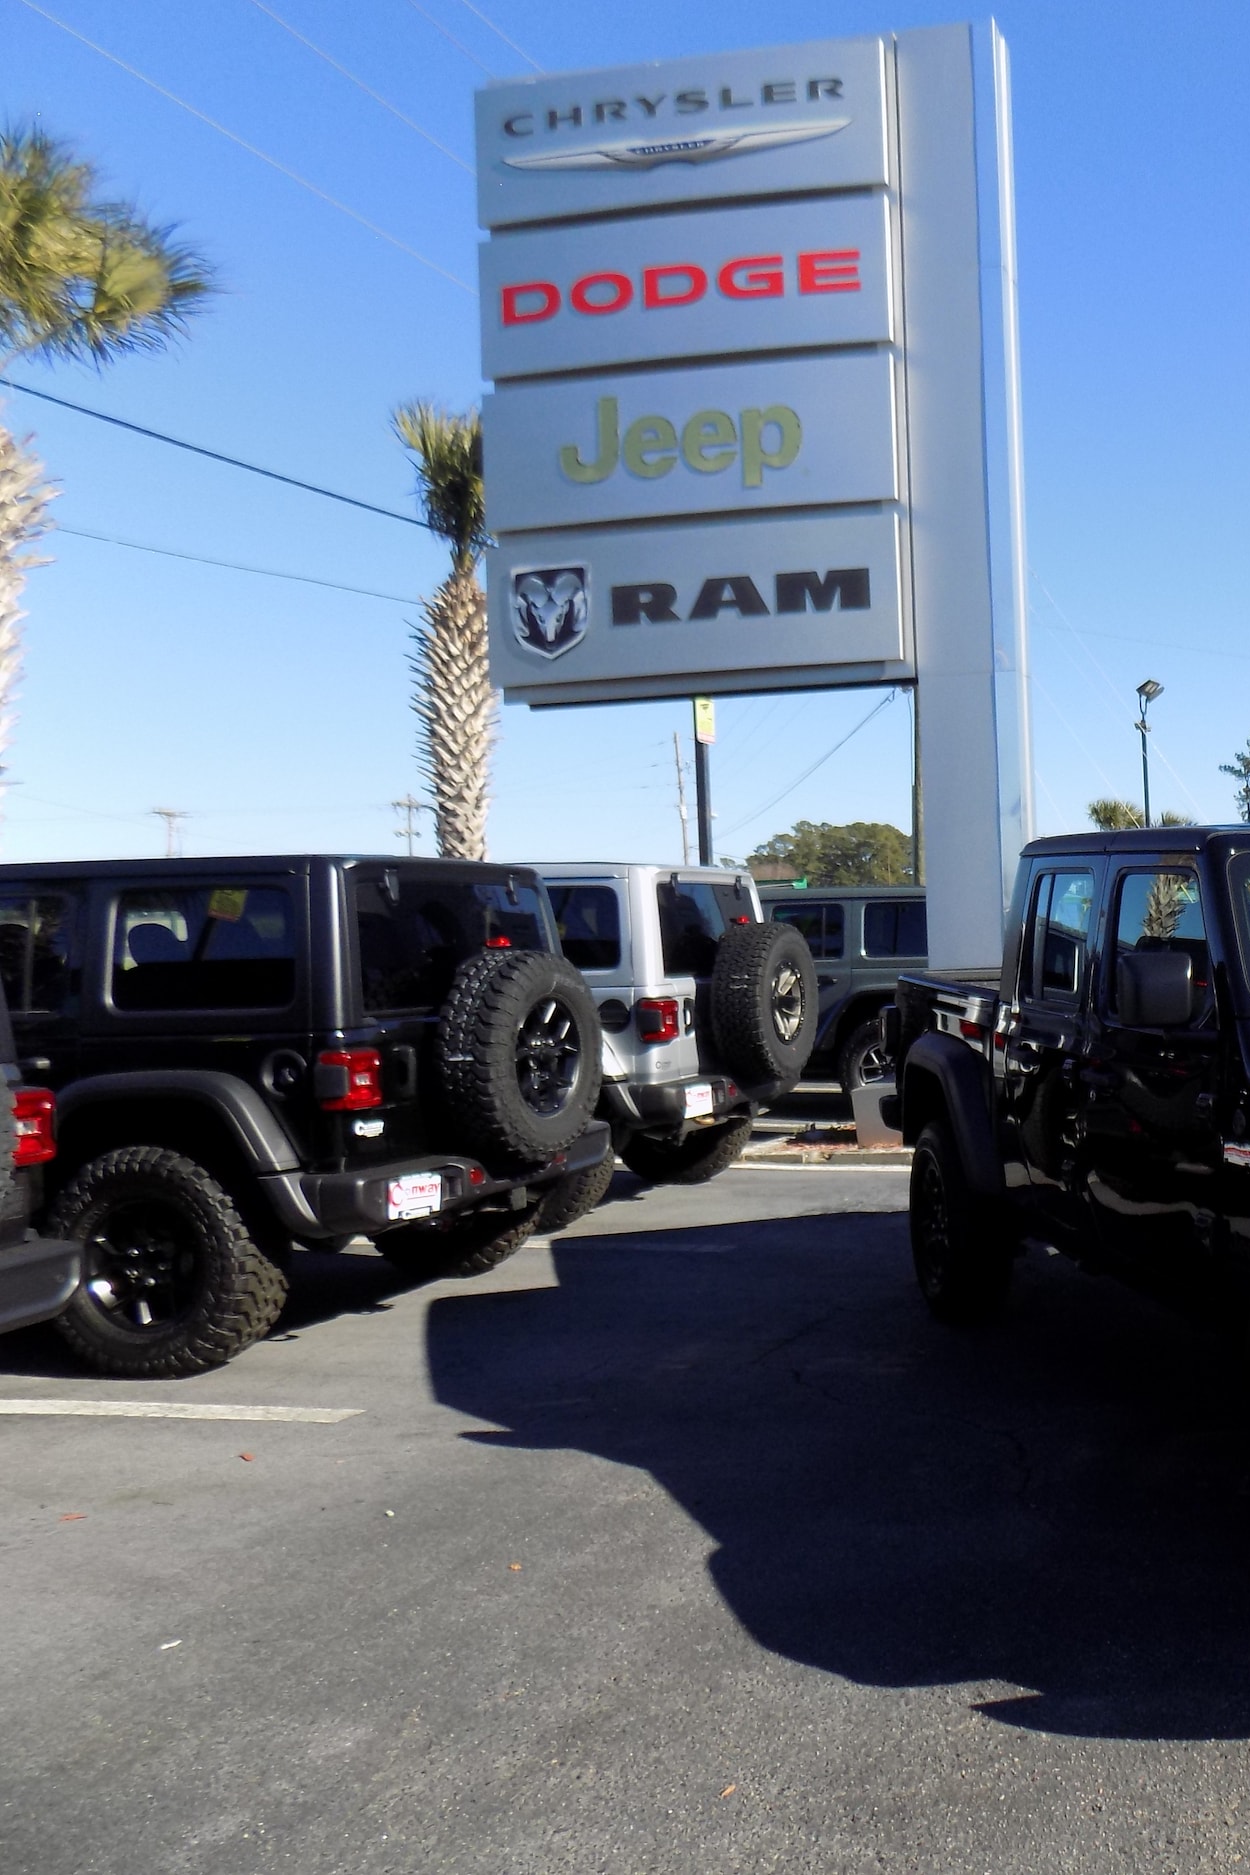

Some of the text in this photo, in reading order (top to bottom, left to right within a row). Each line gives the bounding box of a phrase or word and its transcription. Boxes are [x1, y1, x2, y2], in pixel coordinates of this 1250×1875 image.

[503, 77, 845, 138] CHRYSLER
[501, 249, 862, 327] DODGE
[559, 396, 803, 488] Jeep
[611, 567, 871, 627] RAM
